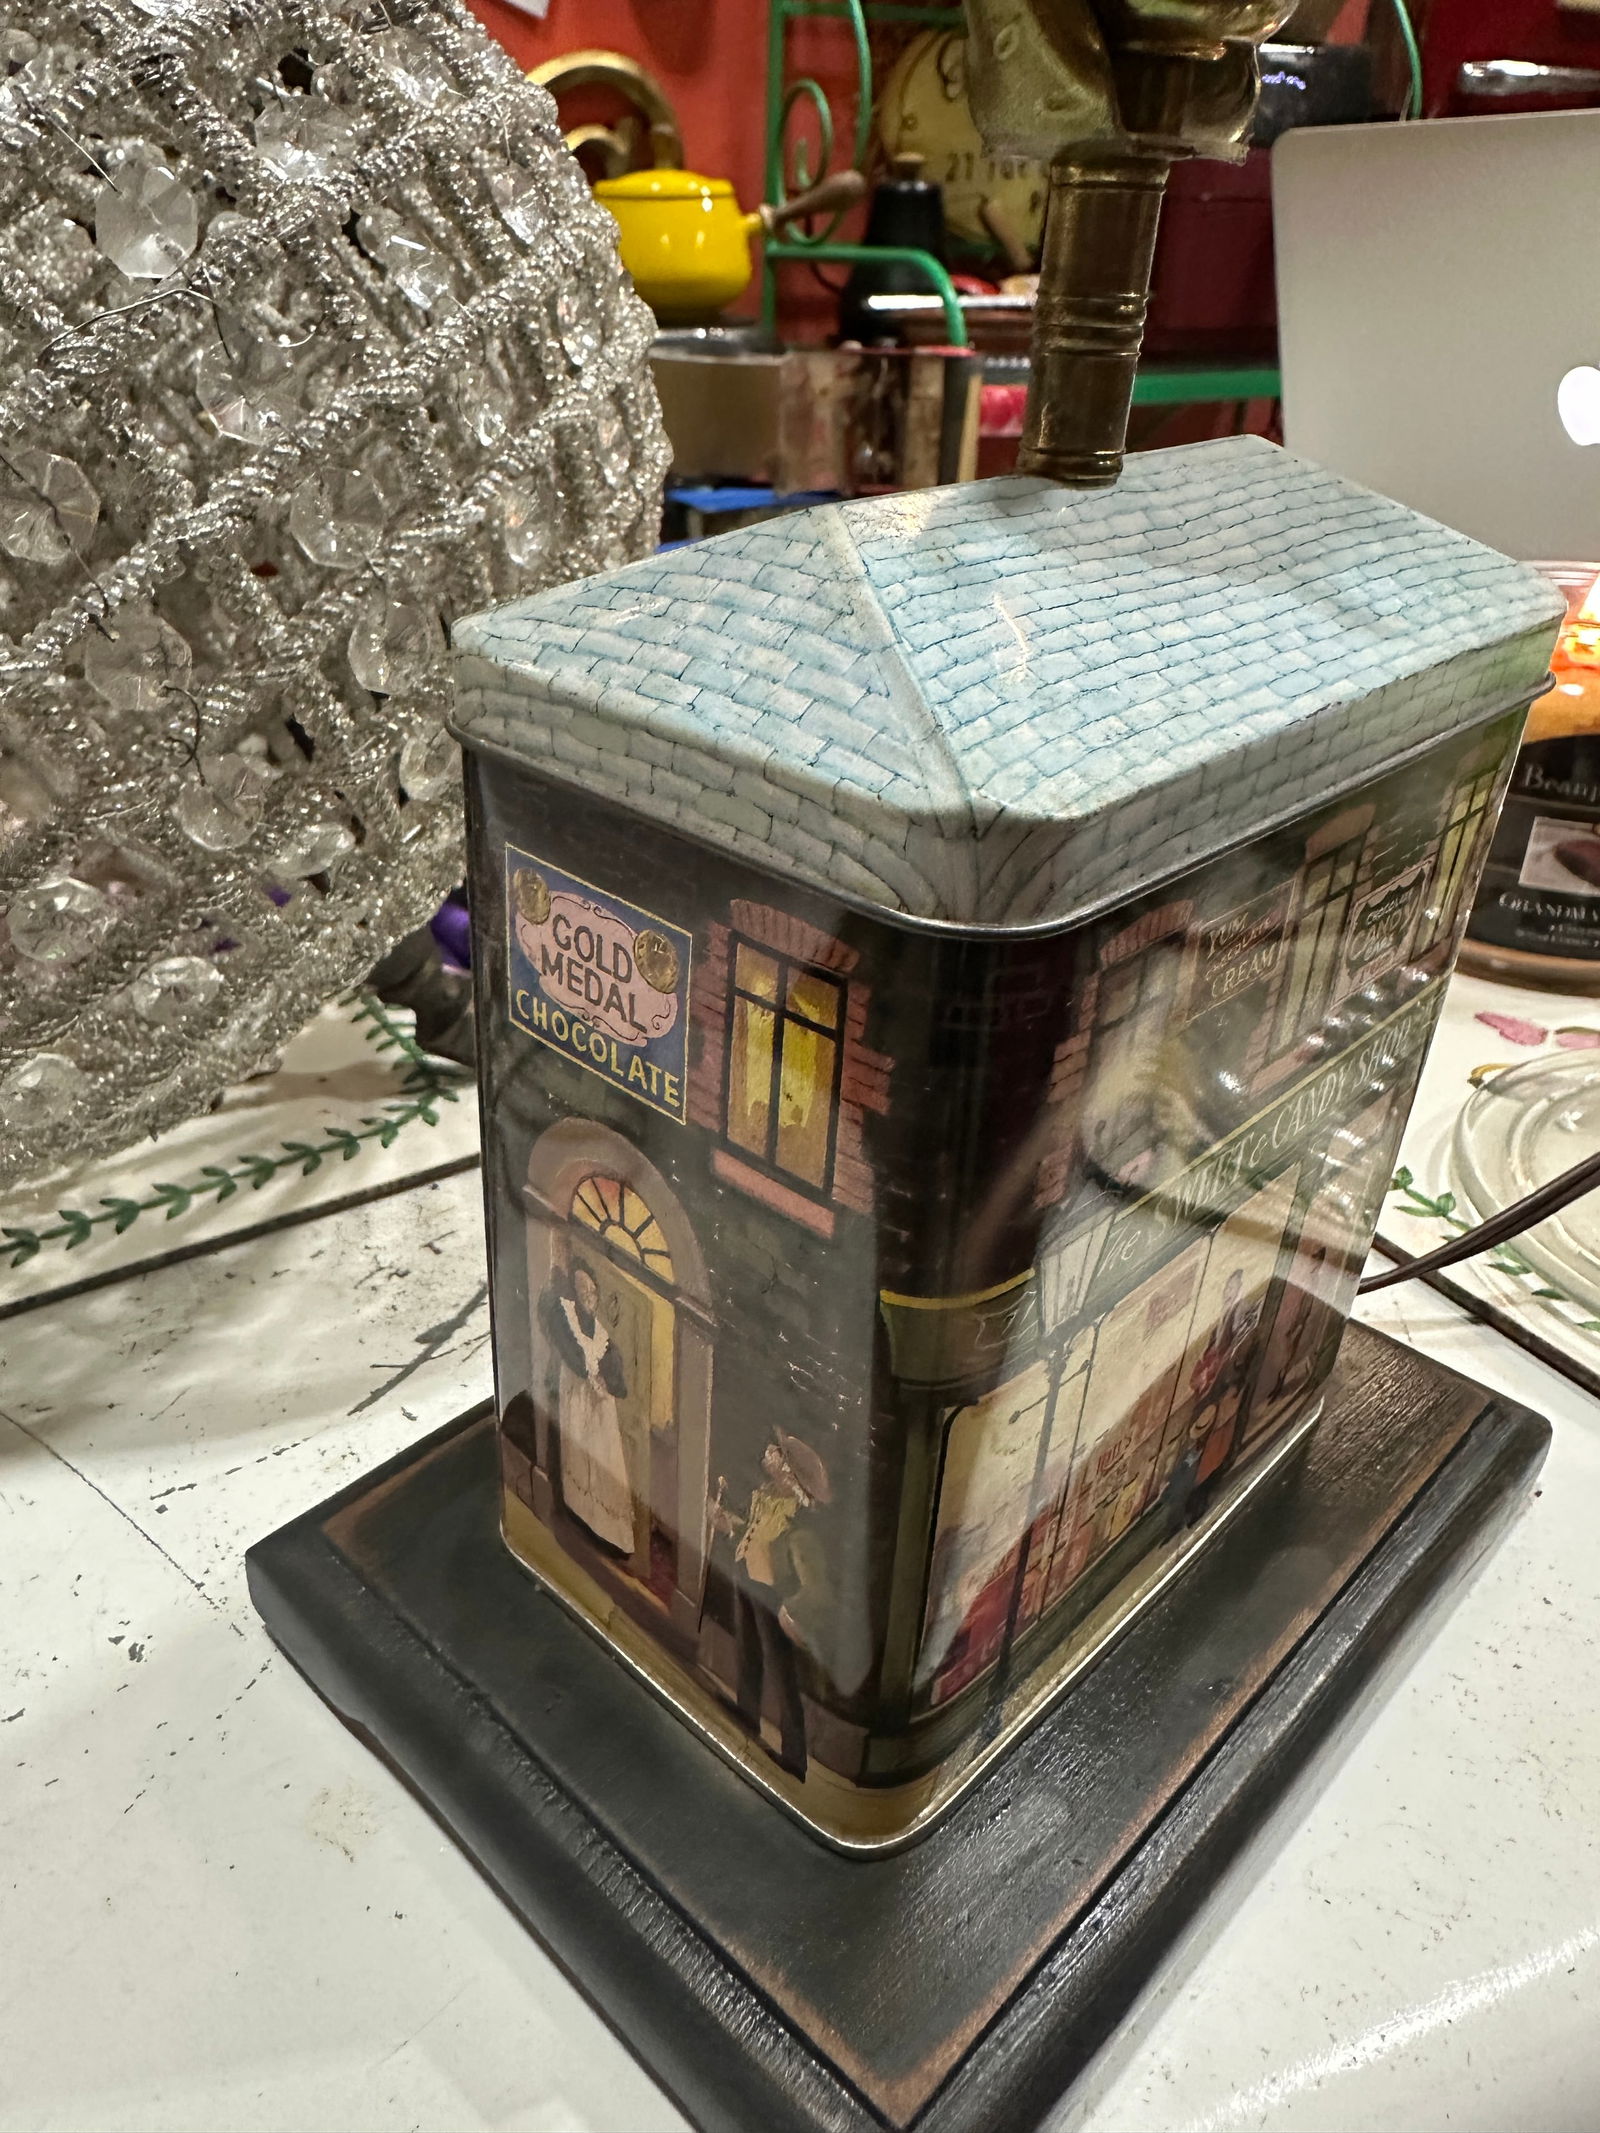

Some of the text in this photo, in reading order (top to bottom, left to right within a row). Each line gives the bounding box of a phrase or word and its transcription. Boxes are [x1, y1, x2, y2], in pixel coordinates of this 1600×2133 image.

[541, 944, 648, 1034] MEDAL
[552, 913, 633, 984] GOLD
[1211, 941, 1278, 998] CREAM
[516, 988, 681, 1108] CHOCOLATE
[1271, 1055, 1354, 1149] CANDY
